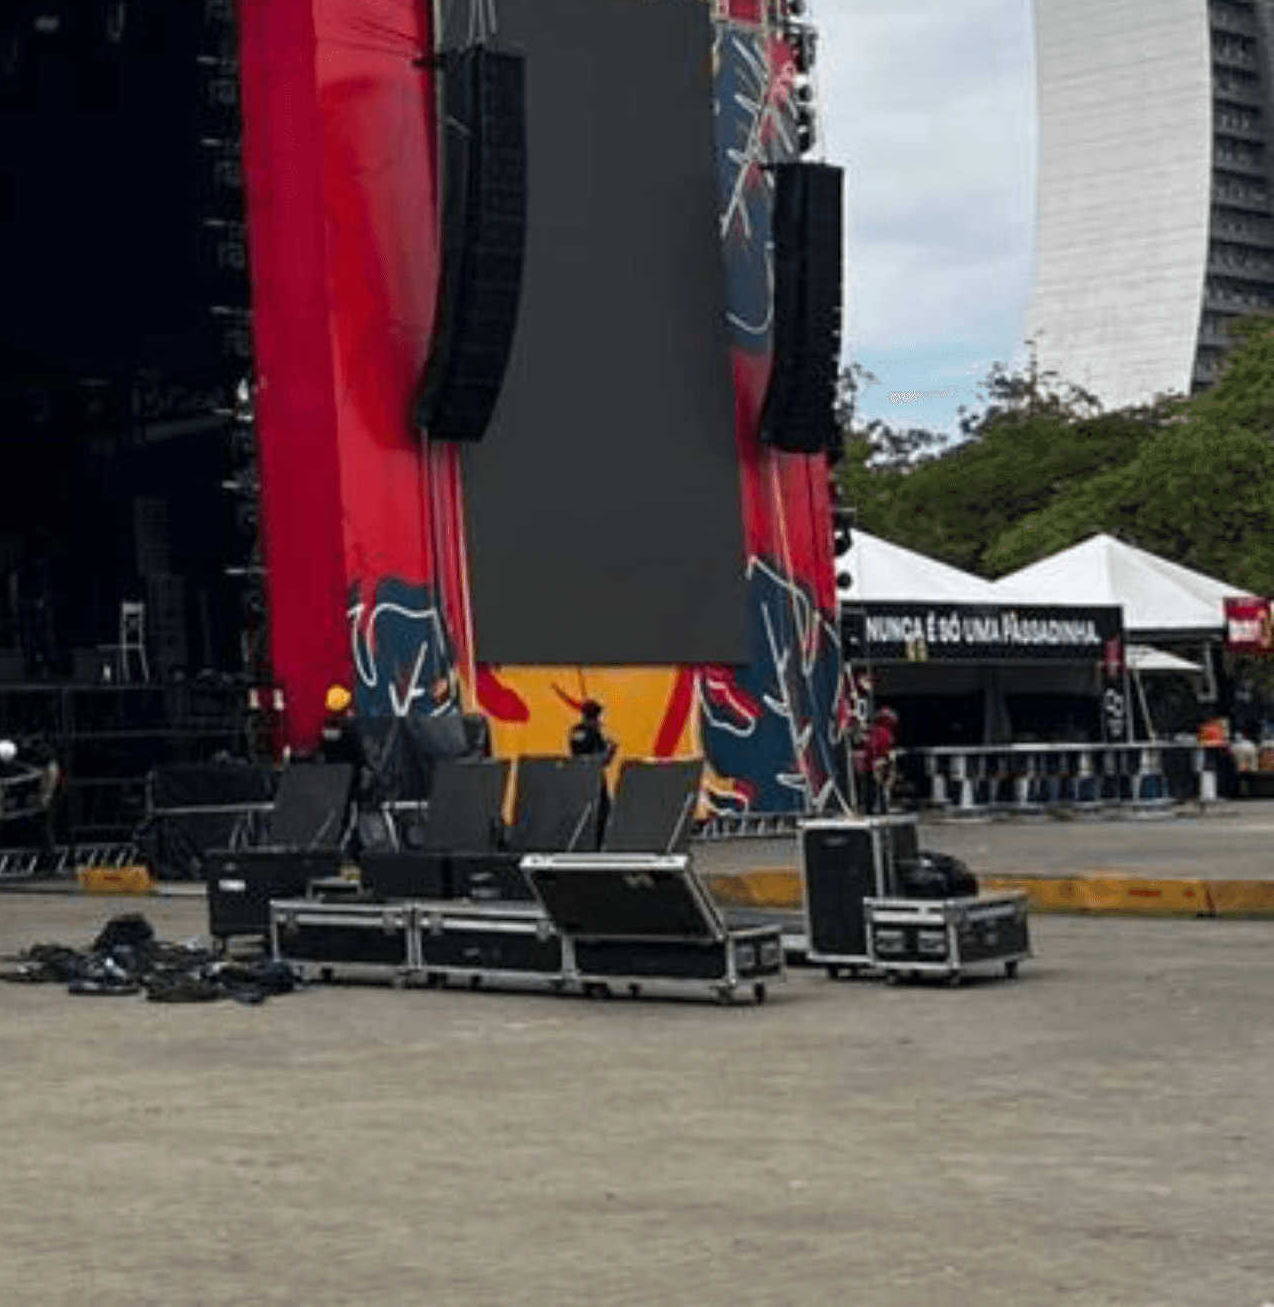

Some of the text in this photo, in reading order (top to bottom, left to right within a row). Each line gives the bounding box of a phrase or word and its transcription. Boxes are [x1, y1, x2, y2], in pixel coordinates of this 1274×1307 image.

[866, 616, 924, 642] NUNCA
[927, 610, 936, 642] É
[939, 610, 961, 643] SÓ
[963, 616, 999, 643] UMA
